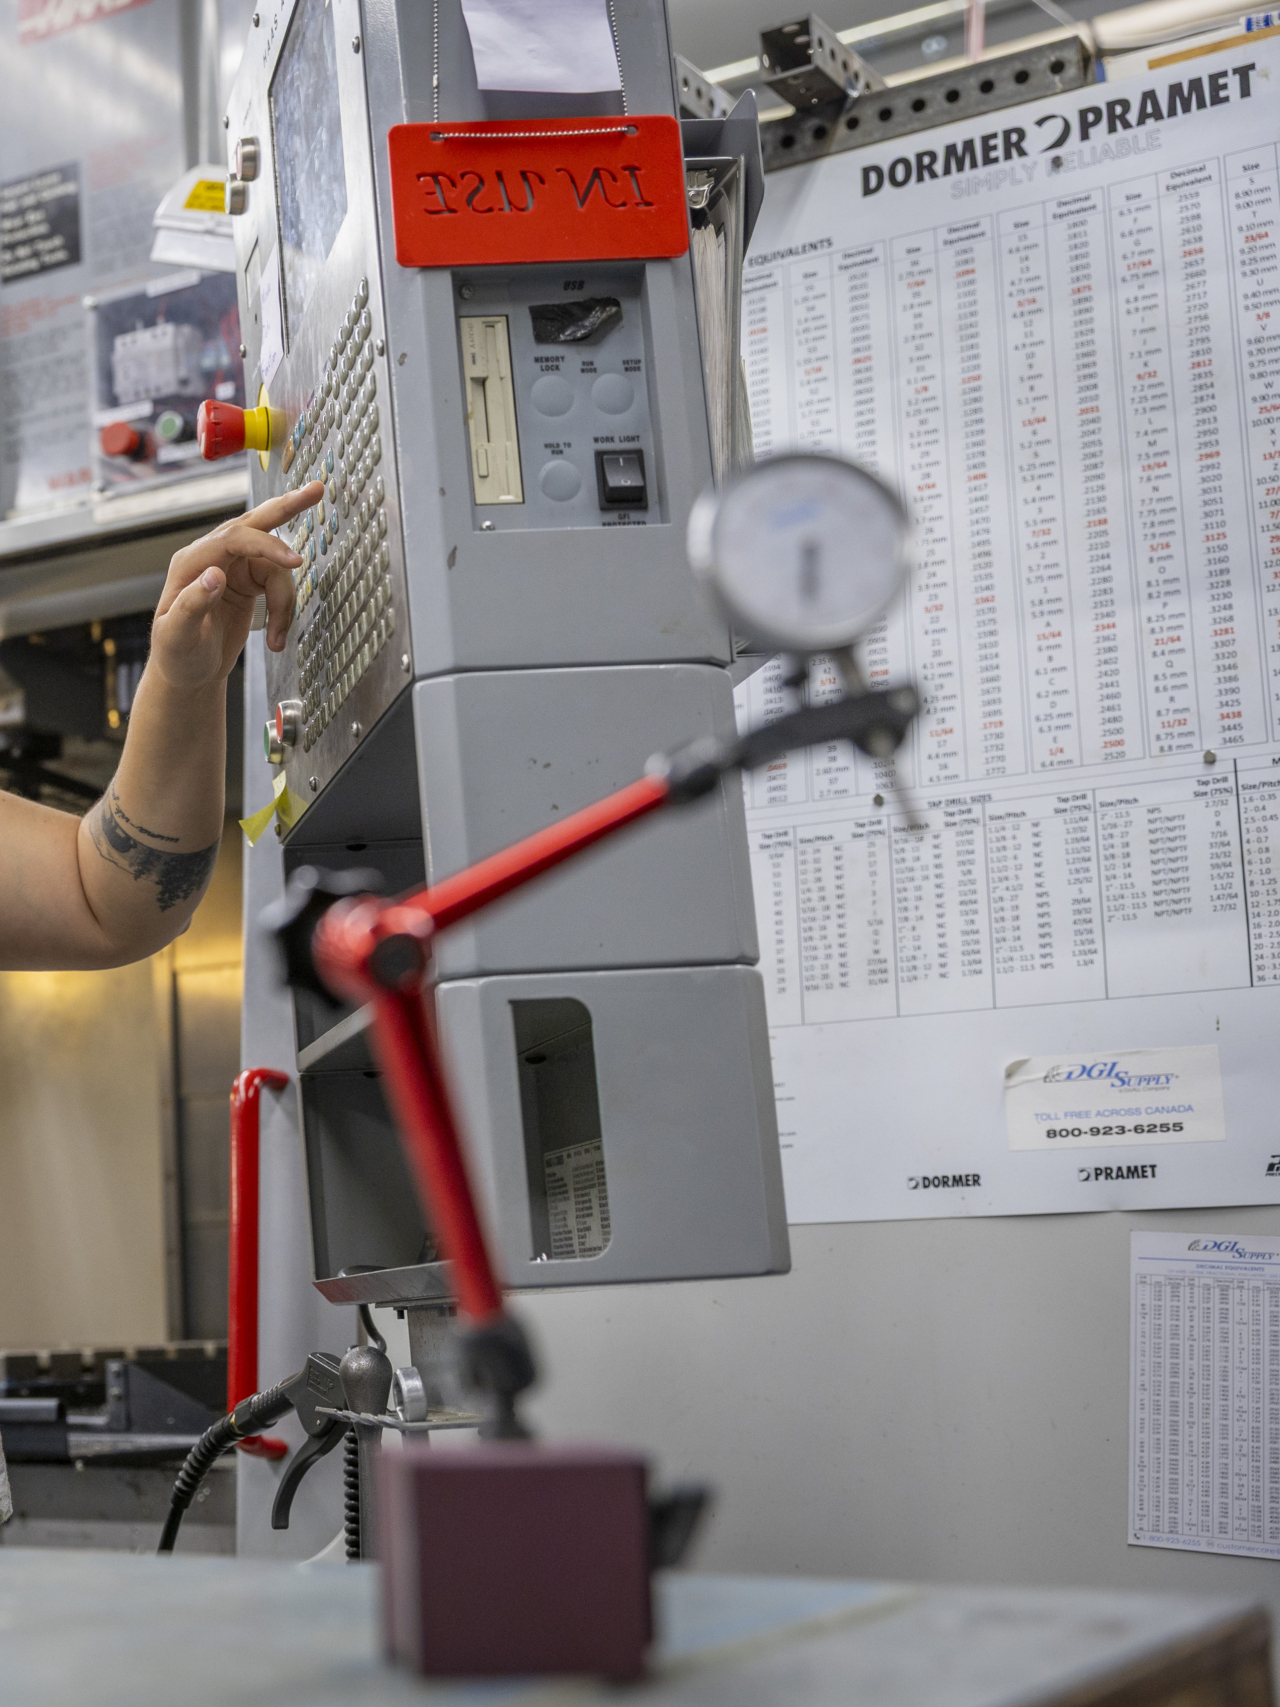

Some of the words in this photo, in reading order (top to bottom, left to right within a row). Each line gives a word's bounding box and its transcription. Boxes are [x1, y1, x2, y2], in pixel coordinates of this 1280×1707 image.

[861, 127, 1028, 197] DORMER
[1078, 63, 1256, 141] PRAMET
[951, 161, 1038, 200] SIMPLY
[1046, 129, 1163, 178] RELIABLE
[1242, 162, 1260, 172] Size
[1170, 164, 1206, 179] Decimal
[1166, 174, 1213, 192] Equivalent
[1235, 189, 1253, 199] 8.90
[1254, 186, 1271, 195] mm
[1235, 200, 1254, 211] 9.00
[1255, 197, 1272, 206] mm
[1257, 220, 1274, 229] mm
[1245, 232, 1269, 244] 23/64
[748, 236, 833, 268] EQUIVALENTS
[1259, 243, 1276, 251] mm
[1260, 254, 1277, 262] mm
[1261, 265, 1278, 274] mm
[563, 280, 585, 290] USB
[1256, 312, 1270, 321] 3/8
[593, 436, 615, 444] WORK
[619, 435, 640, 443] LIGHT
[618, 513, 630, 521] GFI
[1150, 542, 1171, 552] 5/16
[1162, 577, 1180, 585] mm
[1209, 604, 1233, 614] .3248
[1168, 612, 1186, 620] mm
[1209, 615, 1234, 626] .3268
[1210, 627, 1235, 638] .3281
[1155, 635, 1181, 646] 21/64
[1211, 639, 1236, 650] .3307
[1212, 651, 1237, 661] .3320
[1213, 663, 1238, 673] .3346
[1170, 671, 1187, 679] mm
[1214, 675, 1239, 686] .3386
[1215, 687, 1240, 698] .3390
[1216, 699, 1241, 709] .3425
[1172, 707, 1190, 715] mm
[1217, 711, 1242, 722] .3438
[1161, 718, 1187, 729] 11/32
[1218, 723, 1243, 734] .3445
[1177, 731, 1195, 739] mm
[1219, 735, 1244, 746] .3465
[1197, 779, 1210, 787] Tap
[1212, 776, 1229, 785] Drill
[1193, 790, 1208, 798] Size
[1210, 787, 1233, 796] (75%)
[1262, 814, 1279, 822] 0.45
[1256, 836, 1268, 844] 0.7
[1259, 857, 1271, 865] 1.0
[1261, 878, 1277, 886] 1.25
[1266, 888, 1277, 896] 1.5
[1064, 1061, 1120, 1081] DGI
[1110, 1070, 1174, 1088] SUPPLY
[1034, 1112, 1061, 1122] TOLL
[1064, 1110, 1092, 1120] FREE
[1095, 1107, 1142, 1118] ACROSS
[1145, 1104, 1195, 1115] CANADA
[1046, 1122, 1184, 1139] 800-923-6255
[1094, 1164, 1157, 1181] PRAMET
[922, 1173, 981, 1189] DORMER
[1201, 1240, 1240, 1251] DGI
[1232, 1248, 1276, 1260] SUPPLY
[1225, 1264, 1265, 1272] EQUIVALENTS
